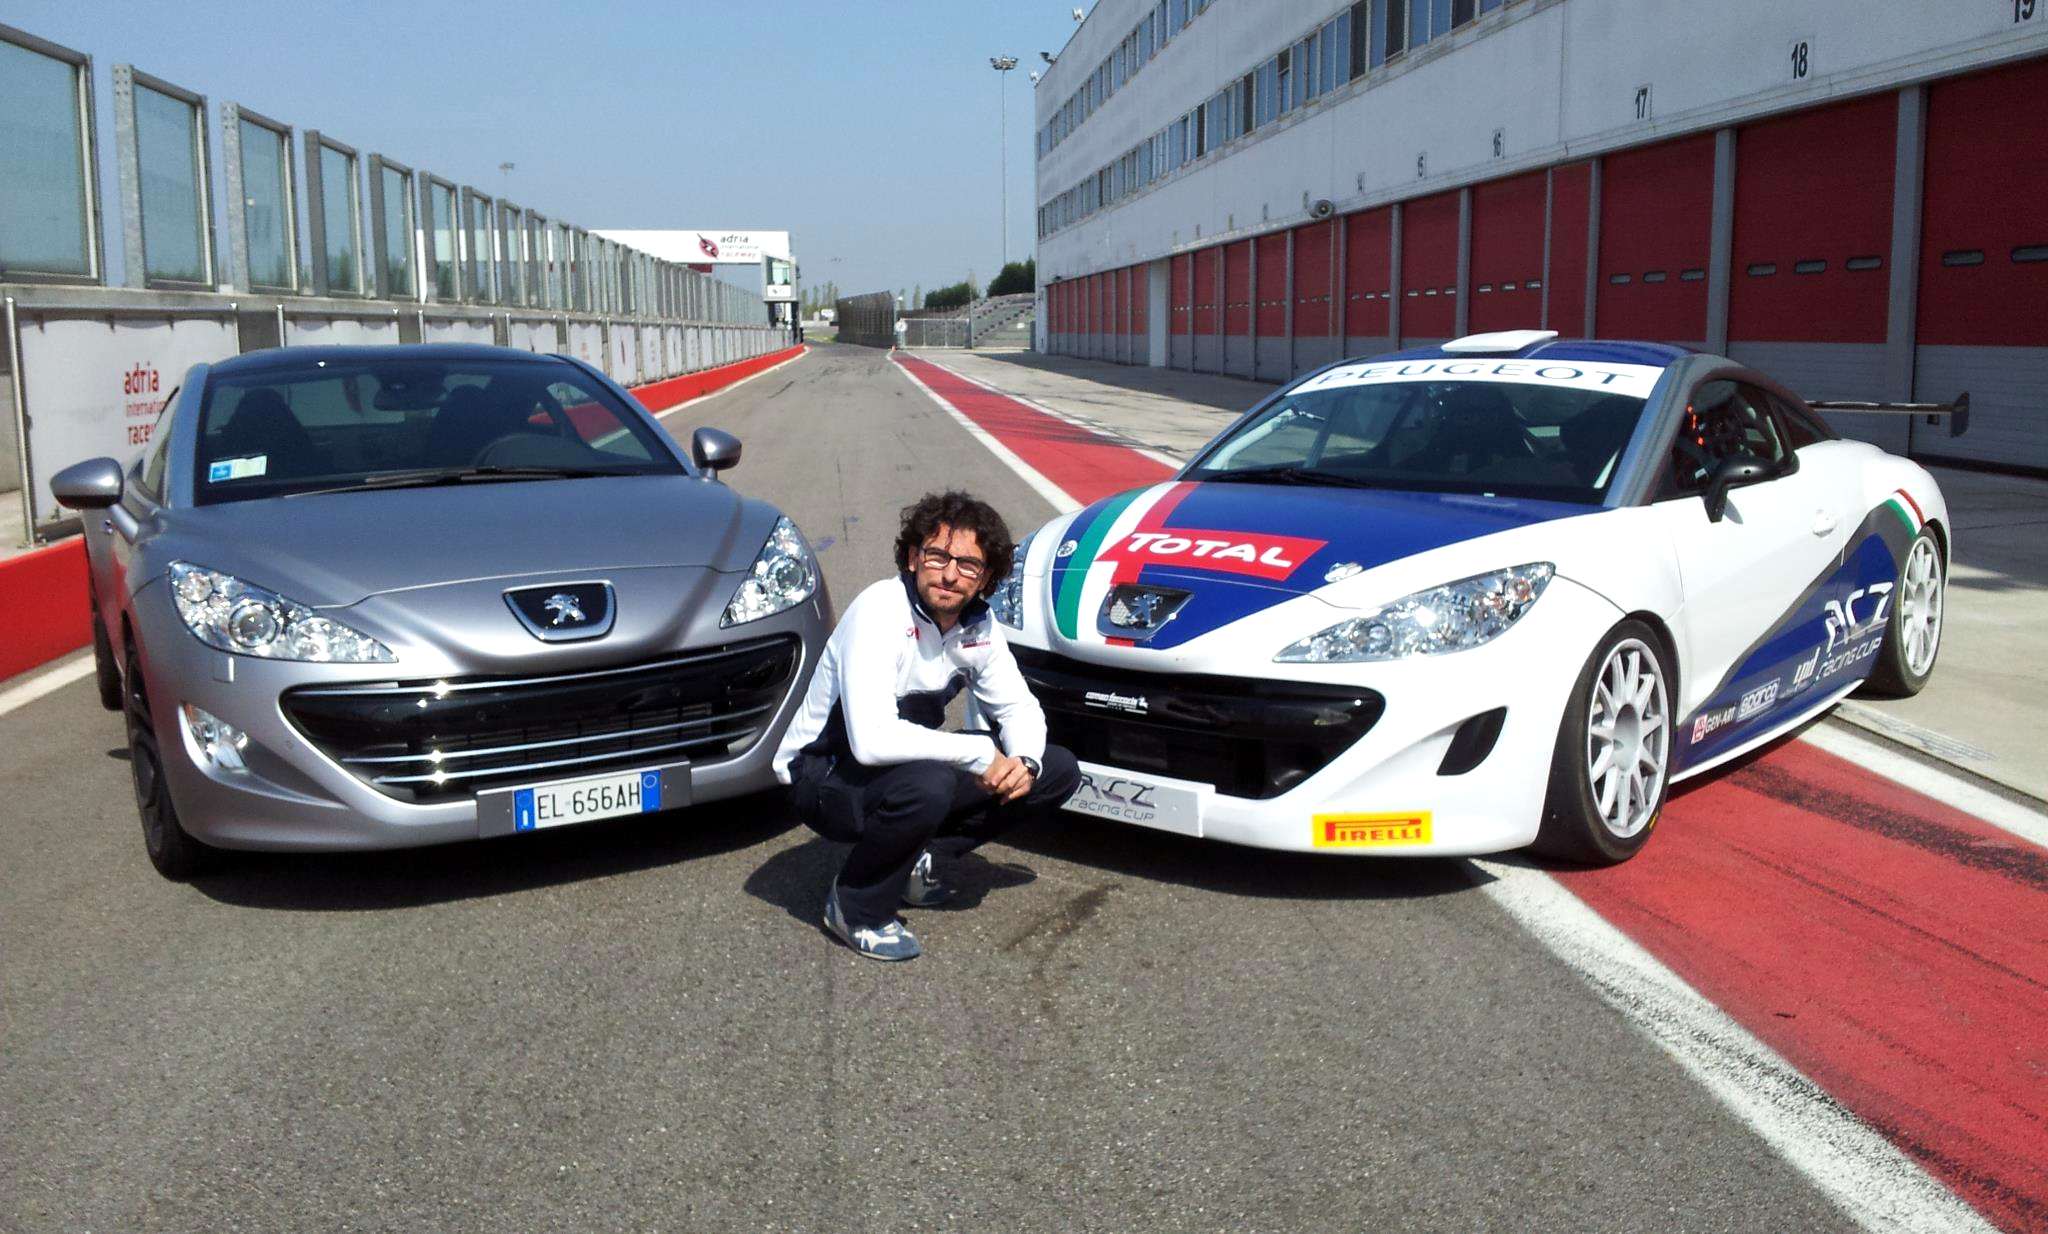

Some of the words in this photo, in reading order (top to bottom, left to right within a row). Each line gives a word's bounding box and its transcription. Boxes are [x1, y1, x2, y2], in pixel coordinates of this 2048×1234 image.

[1791, 41, 1809, 80] 18
[1635, 87, 1648, 120] 17
[720, 233, 750, 244] adria
[125, 361, 160, 395] adria
[1316, 362, 1636, 386] PEUGEOT
[1127, 532, 1293, 568] TOTAL
[537, 793, 564, 820] EL
[572, 781, 641, 816] 656AH
[1077, 773, 1156, 808] RCZ
[1123, 808, 1155, 822] CUP
[1325, 818, 1422, 842] PIRELLI
